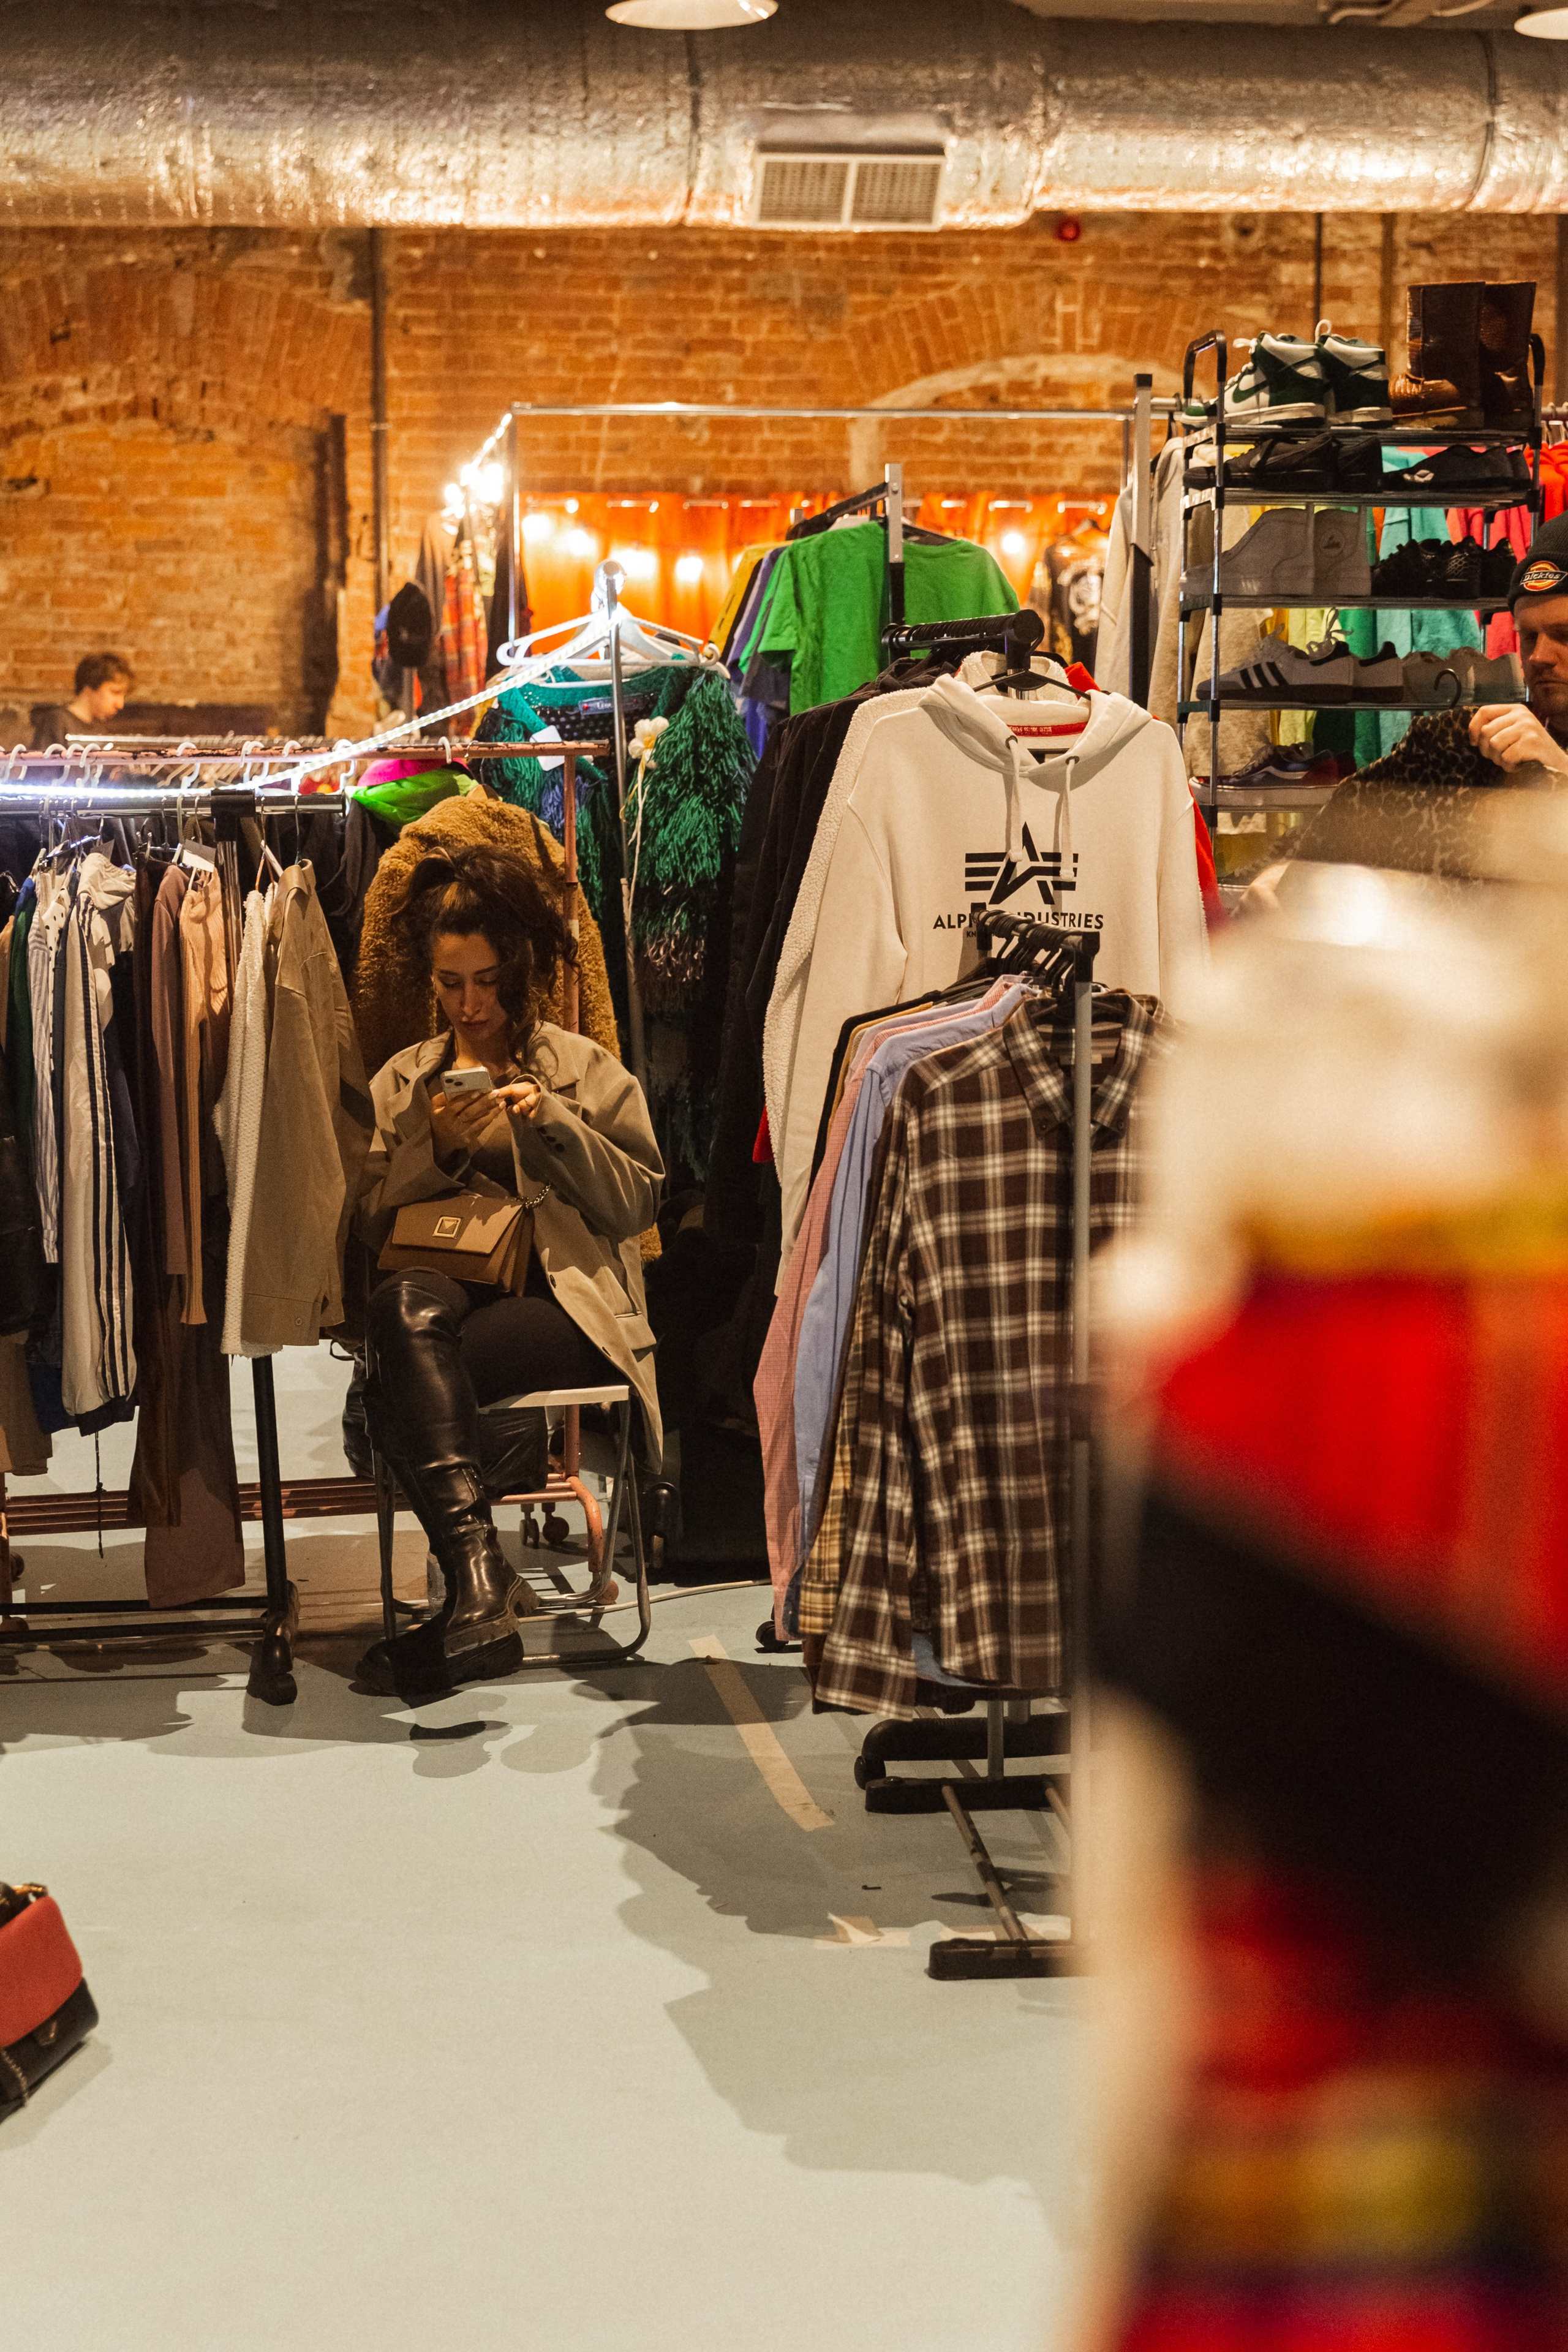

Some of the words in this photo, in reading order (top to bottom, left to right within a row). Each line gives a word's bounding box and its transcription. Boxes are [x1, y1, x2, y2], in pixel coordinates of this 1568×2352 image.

[1523, 572, 1561, 582] Dickies
[932, 913, 973, 929] ALP
[1017, 911, 1104, 930] DUSTRIES
